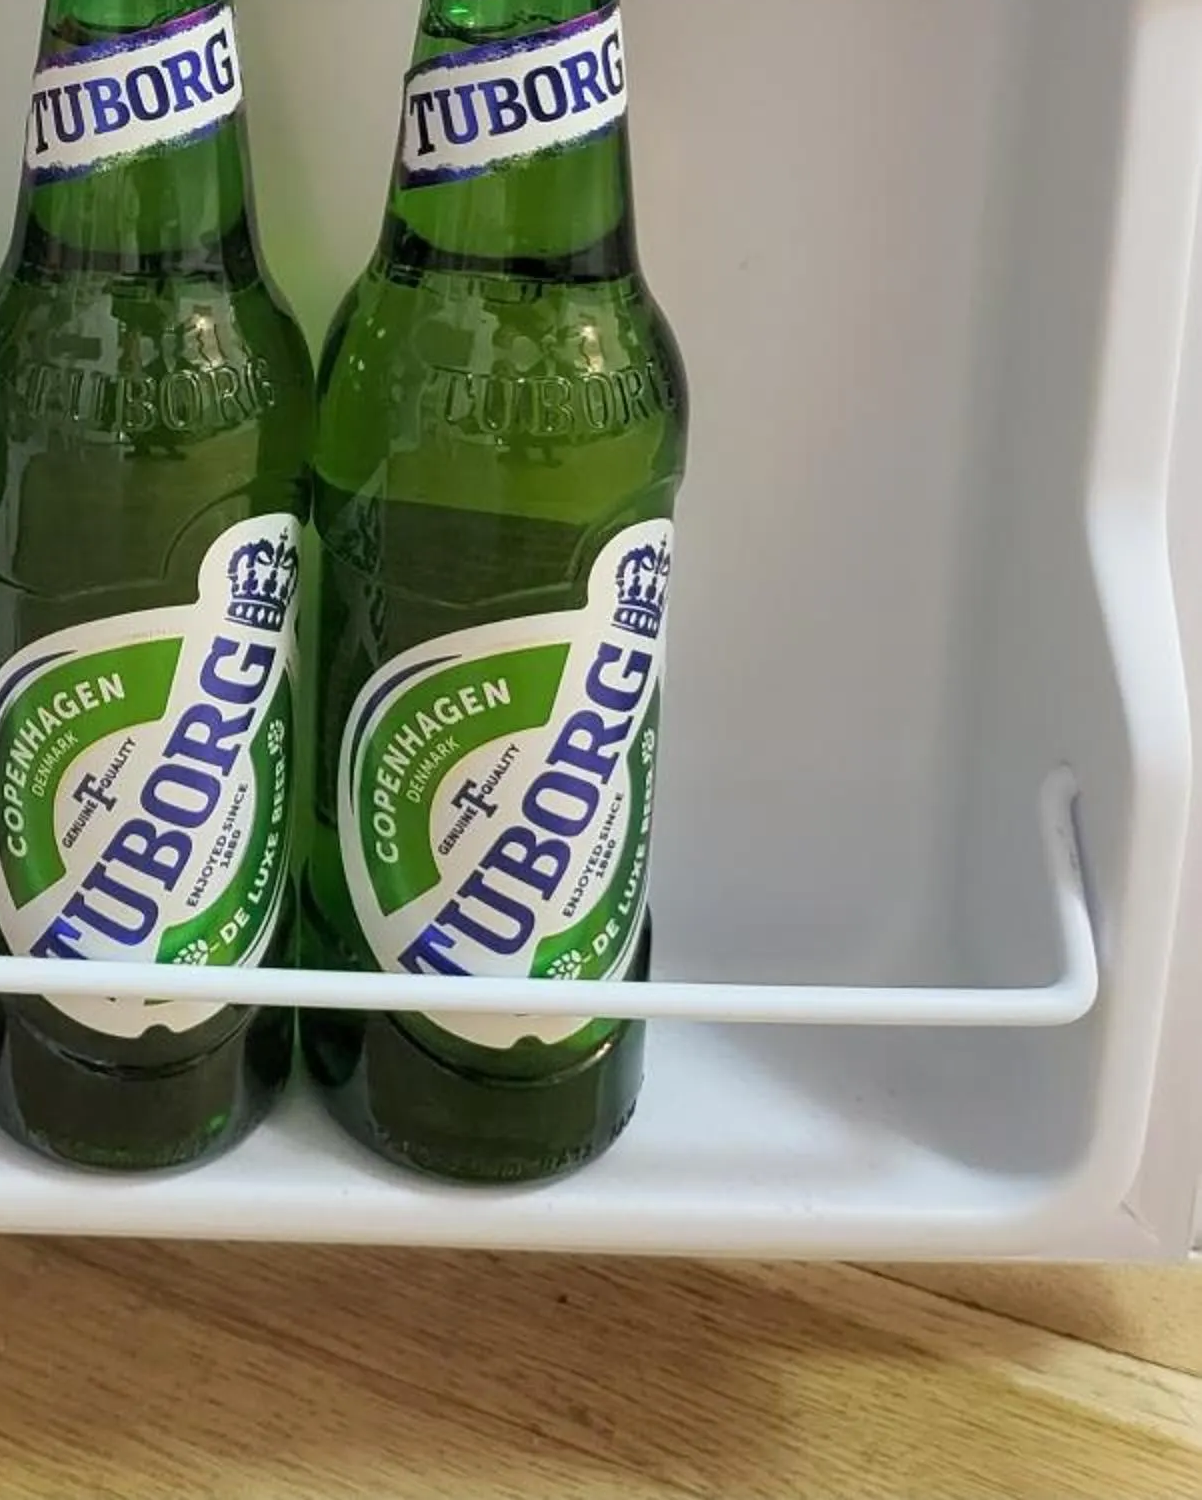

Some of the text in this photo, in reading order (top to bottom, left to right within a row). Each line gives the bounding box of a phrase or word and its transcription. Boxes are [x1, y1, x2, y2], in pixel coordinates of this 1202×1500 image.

[31, 27, 235, 155] TUBORG
[409, 29, 624, 156] TUBORG
[2, 672, 126, 858] COPENHAGEN
[29, 635, 276, 961] TUBORG
[30, 731, 79, 798] DENMARK
[61, 798, 99, 850] GENUINE
[99, 735, 138, 790] QUALITY
[373, 678, 512, 864] COPENHAGEN
[397, 641, 654, 977] TUBORG
[405, 735, 461, 804] DENMARK
[437, 803, 479, 856] GENUINE
[479, 742, 521, 796] QUALITY
[186, 782, 249, 908] ENJOYED SINCE
[219, 906, 251, 946] DE
[247, 830, 280, 905] LUXE
[562, 792, 626, 919] ENJOYED SINCE
[591, 920, 621, 956] DE
[618, 843, 646, 916] LUXE
